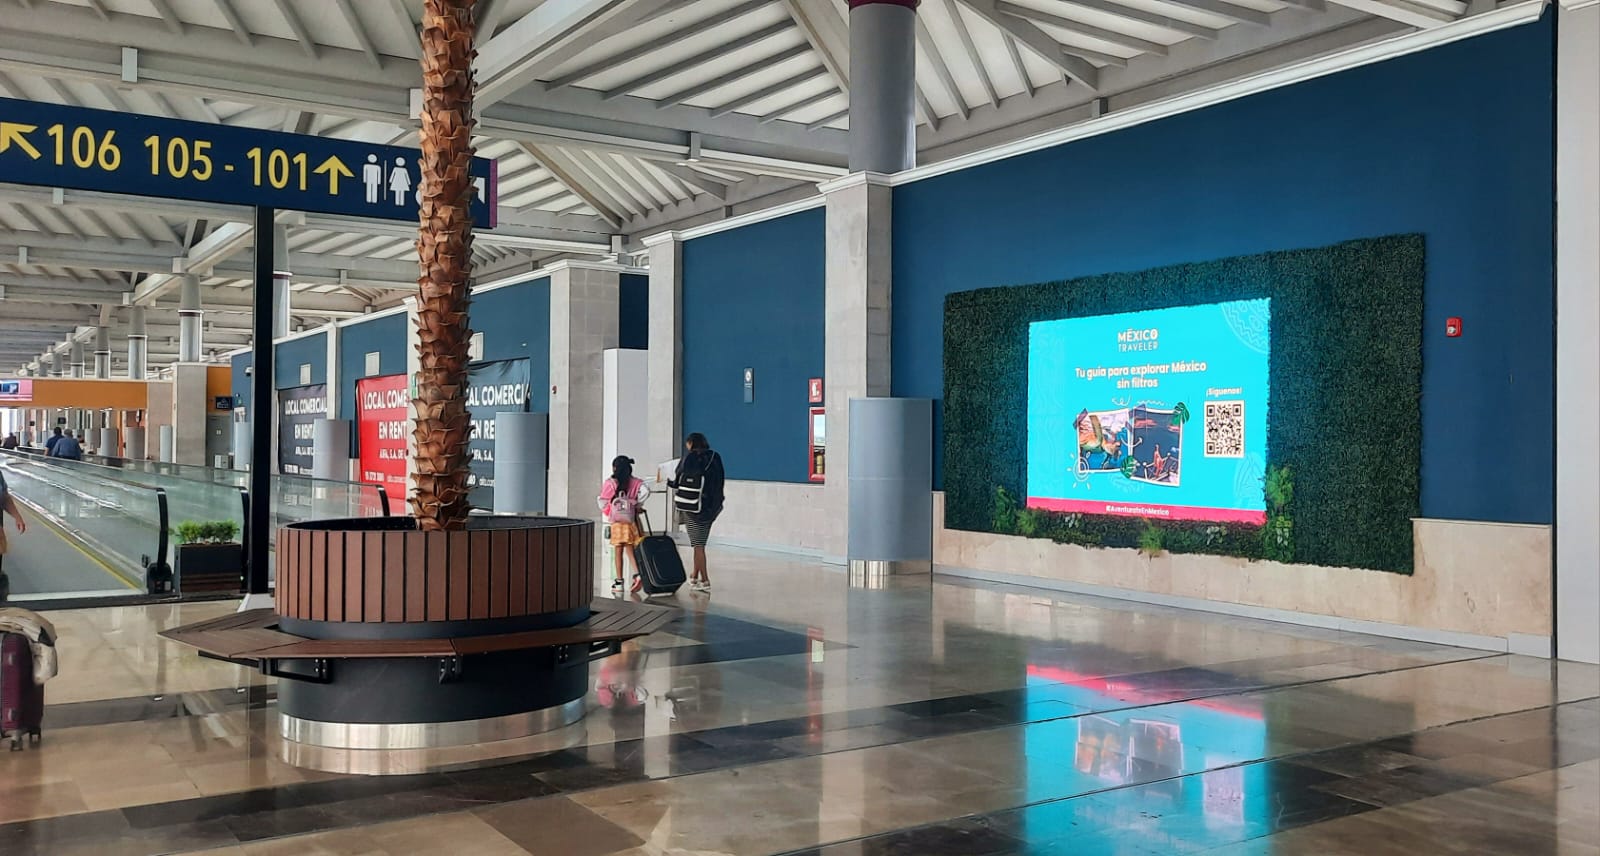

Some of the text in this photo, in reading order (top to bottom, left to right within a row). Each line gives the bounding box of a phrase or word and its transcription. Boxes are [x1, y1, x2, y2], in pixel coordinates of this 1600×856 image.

[47, 123, 122, 171] 106
[144, 135, 213, 182] 105
[246, 147, 307, 191] 101
[1117, 328, 1158, 342] MÉXICO
[1118, 341, 1158, 352] TRAVELER
[1075, 361, 1207, 381] Tu guía para explorar México
[1116, 377, 1158, 389] sin filtros
[364, 388, 408, 410] LOCAL COME
[378, 420, 408, 439] EN RENT
[483, 419, 495, 439] RE
